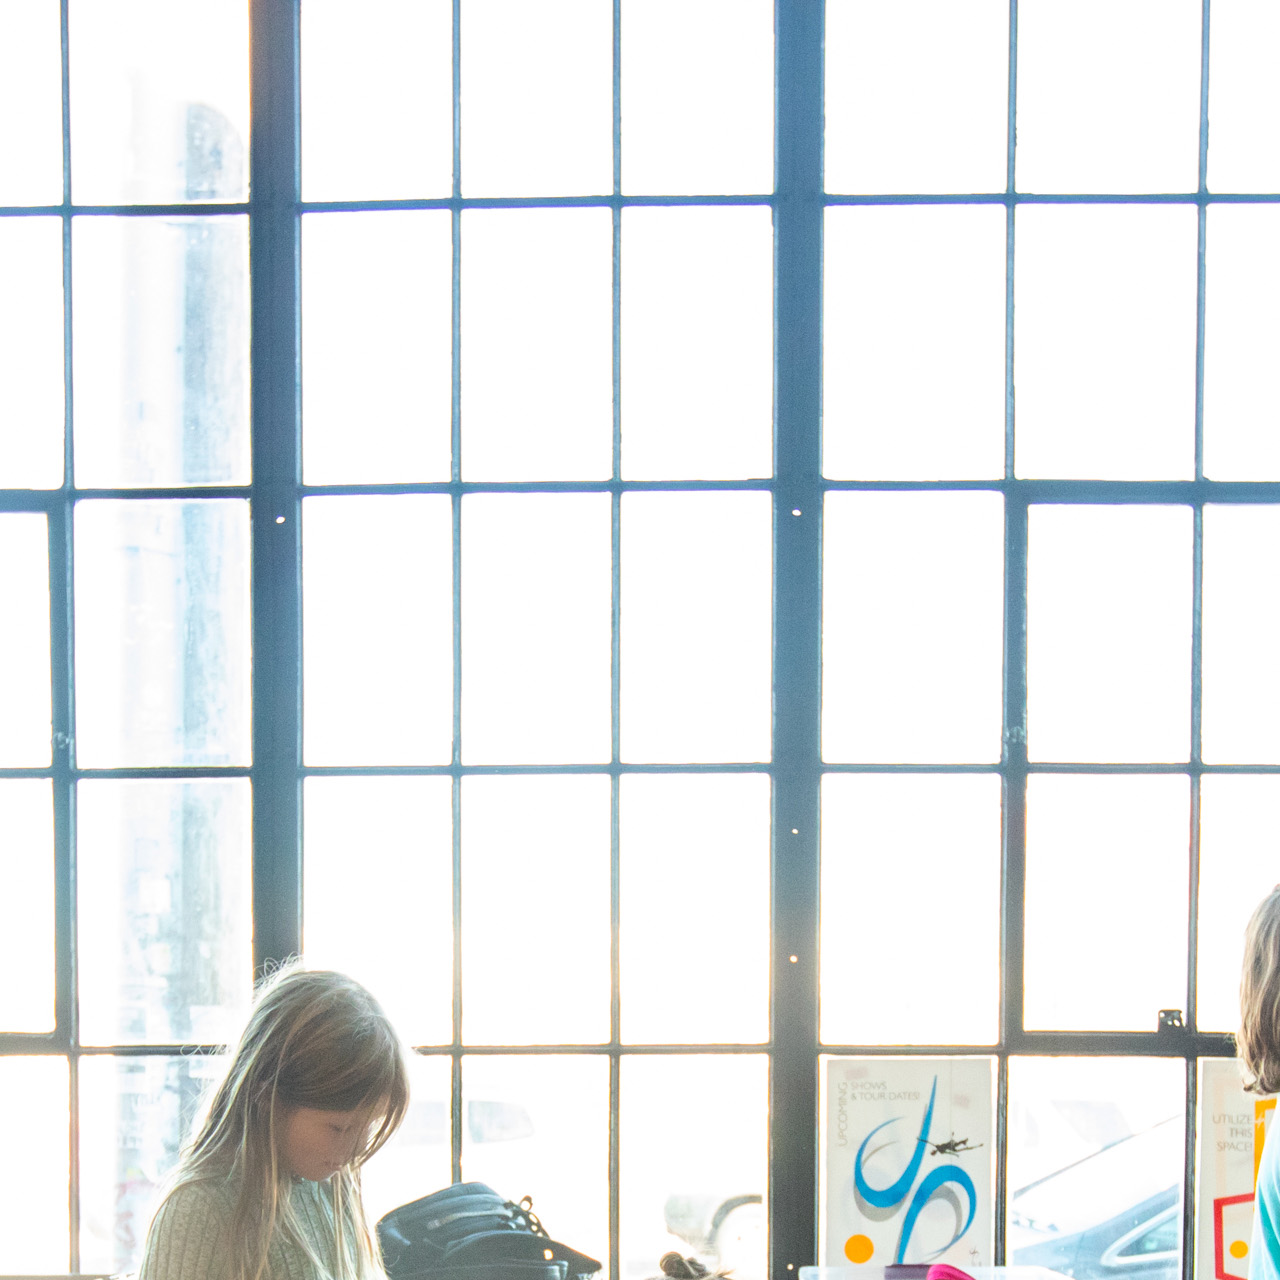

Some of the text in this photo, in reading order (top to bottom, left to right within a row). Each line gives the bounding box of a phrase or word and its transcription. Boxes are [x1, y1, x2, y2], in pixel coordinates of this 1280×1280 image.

[850, 1081, 887, 1091] SHOWS
[851, 1093, 857, 1101] &
[860, 1092, 885, 1101] TOUR
[838, 1081, 848, 1146] UPCOMING
[1212, 1113, 1253, 1125] UTILIZE
[1229, 1127, 1253, 1138] THIS
